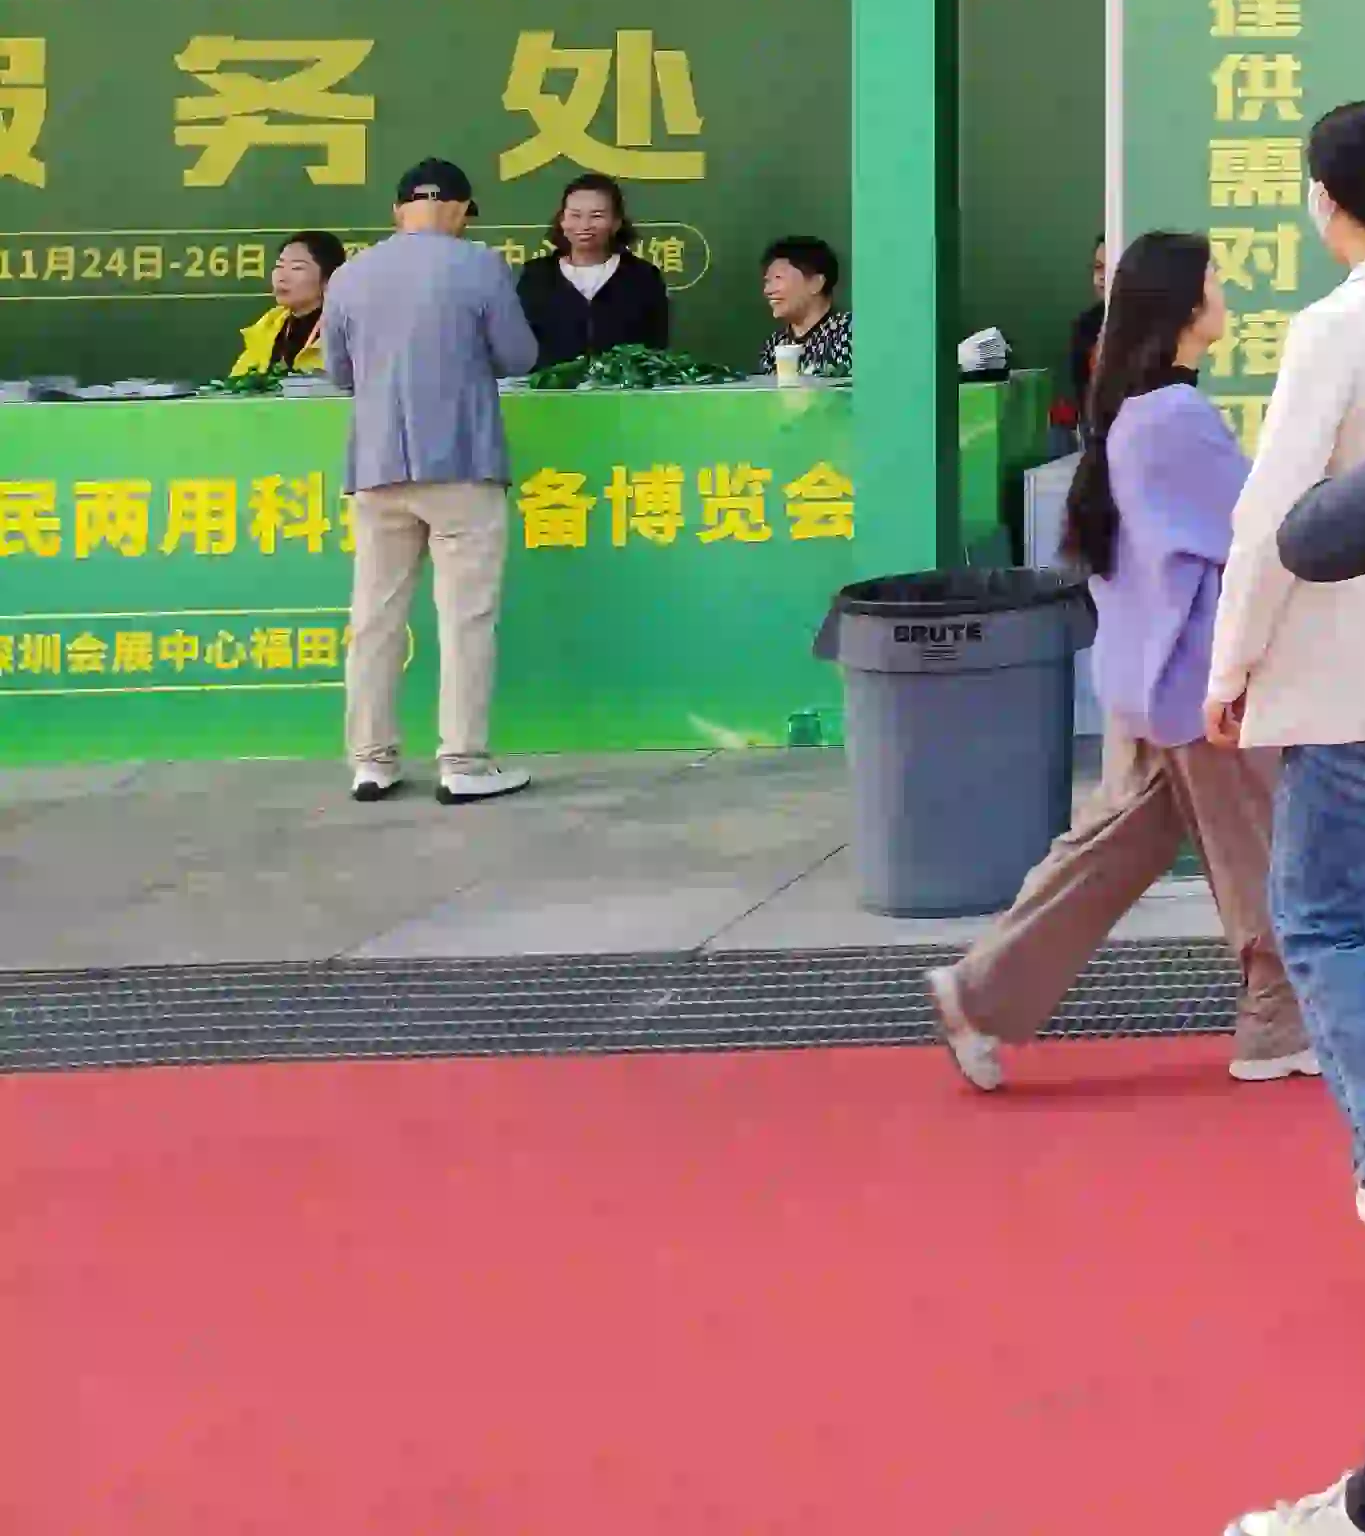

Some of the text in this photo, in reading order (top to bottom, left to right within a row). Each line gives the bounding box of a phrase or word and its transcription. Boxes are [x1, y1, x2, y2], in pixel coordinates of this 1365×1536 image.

[0, 29, 705, 189] 务处
[0, 461, 857, 560] 民两用科备博览会
[0, 626, 352, 677] 圳会展中心福田
[893, 622, 983, 644] BRUTE
